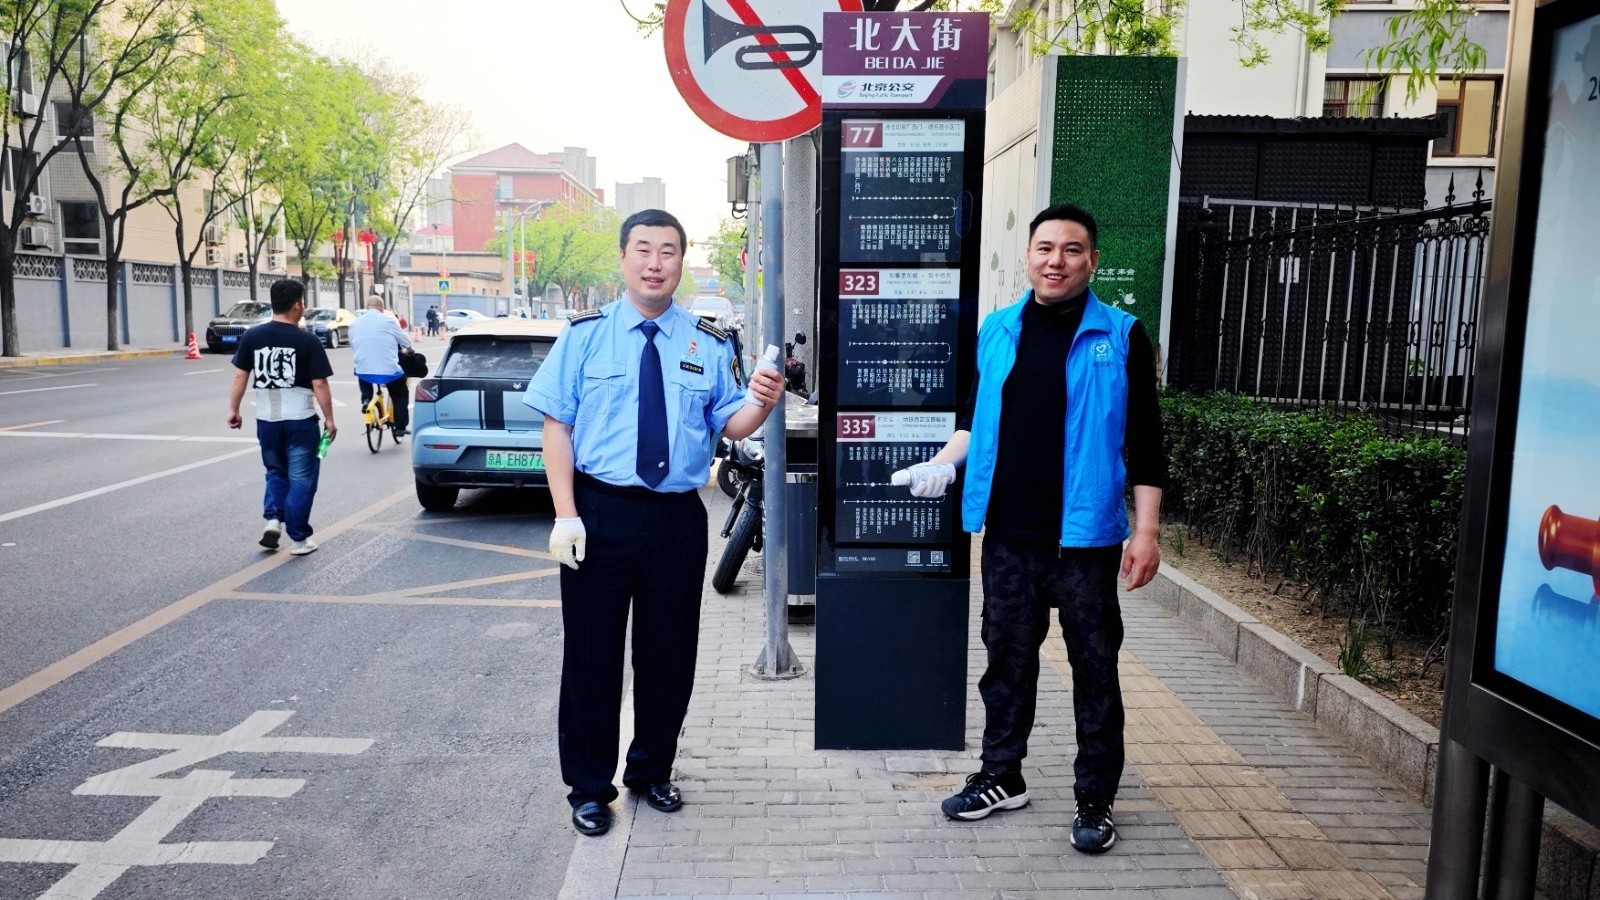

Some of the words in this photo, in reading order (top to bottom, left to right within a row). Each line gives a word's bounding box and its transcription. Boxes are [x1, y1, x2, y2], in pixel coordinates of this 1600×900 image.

[849, 18, 962, 51] 北大街
[865, 57, 888, 69] BEI
[893, 57, 916, 69] DA
[921, 57, 945, 69] JIE
[861, 82, 915, 91] 北京公交
[1588, 76, 1600, 101] 2
[850, 127, 875, 143] 77
[844, 275, 876, 291] 323
[842, 419, 870, 434] 335
[508, 454, 545, 467] EH877
